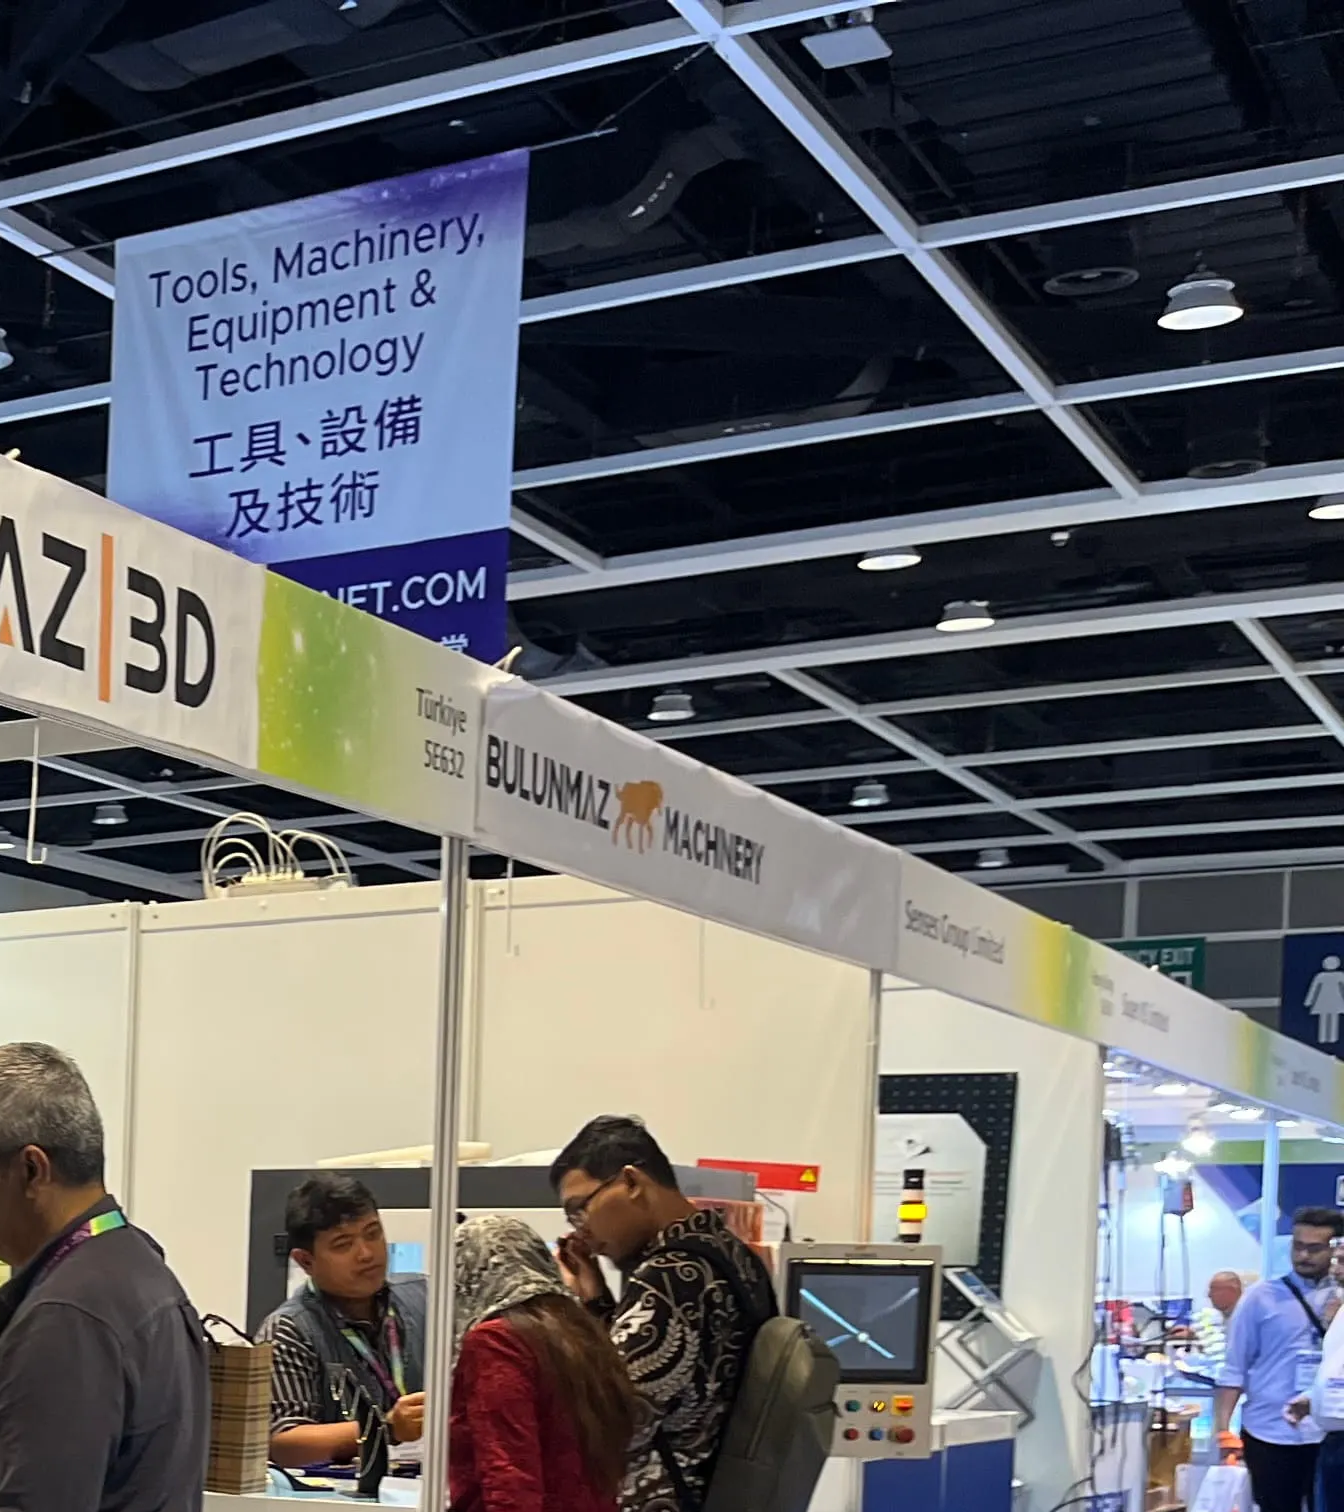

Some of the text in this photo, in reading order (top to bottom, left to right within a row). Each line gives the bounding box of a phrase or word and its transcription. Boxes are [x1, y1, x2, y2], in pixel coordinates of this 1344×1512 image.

[149, 212, 485, 308] Tools, Machinery,
[187, 268, 437, 354] Equipment &
[195, 332, 425, 401] Technology
[189, 396, 423, 479] 工具、設備
[225, 469, 380, 540] 及技術
[124, 567, 216, 708] 3D
[416, 687, 467, 737] Türkiye
[424, 739, 465, 779] 5E632
[486, 734, 765, 885] BULUNMAZ MACHINERY
[1161, 946, 1195, 966] EXIT
